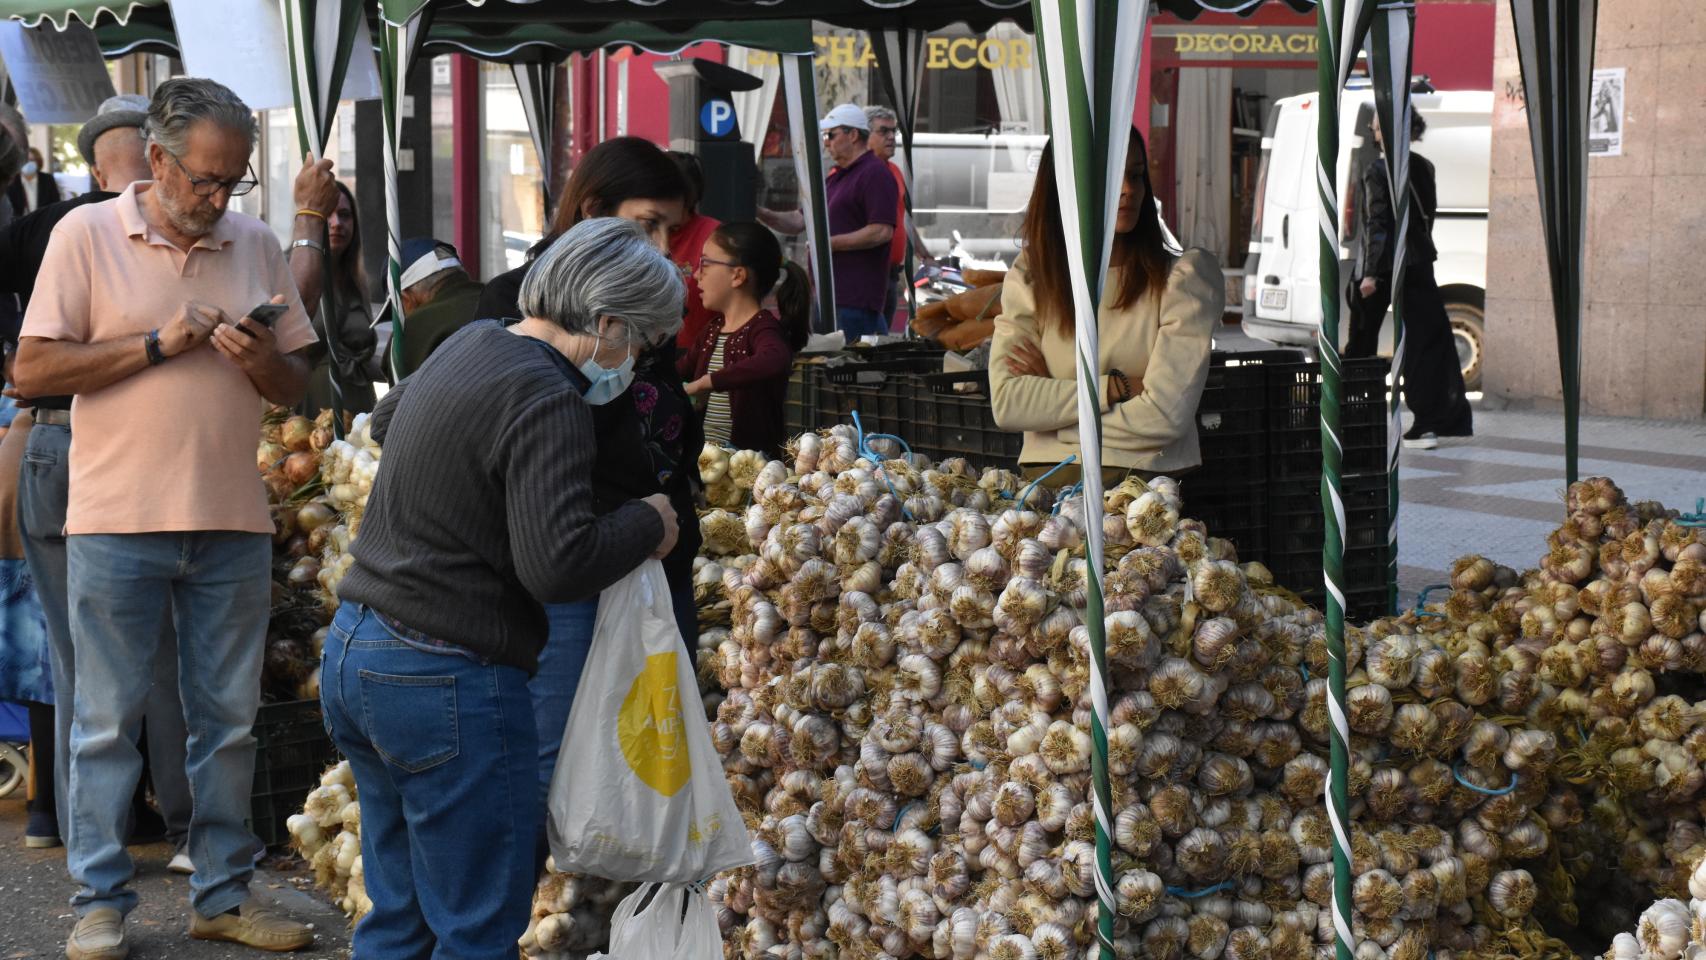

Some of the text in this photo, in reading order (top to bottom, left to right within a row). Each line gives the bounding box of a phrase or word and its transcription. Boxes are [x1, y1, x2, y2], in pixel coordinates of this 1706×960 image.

[926, 37, 1032, 69] ECOR
[1175, 32, 1318, 53] DECORACI
[711, 100, 731, 134] P
